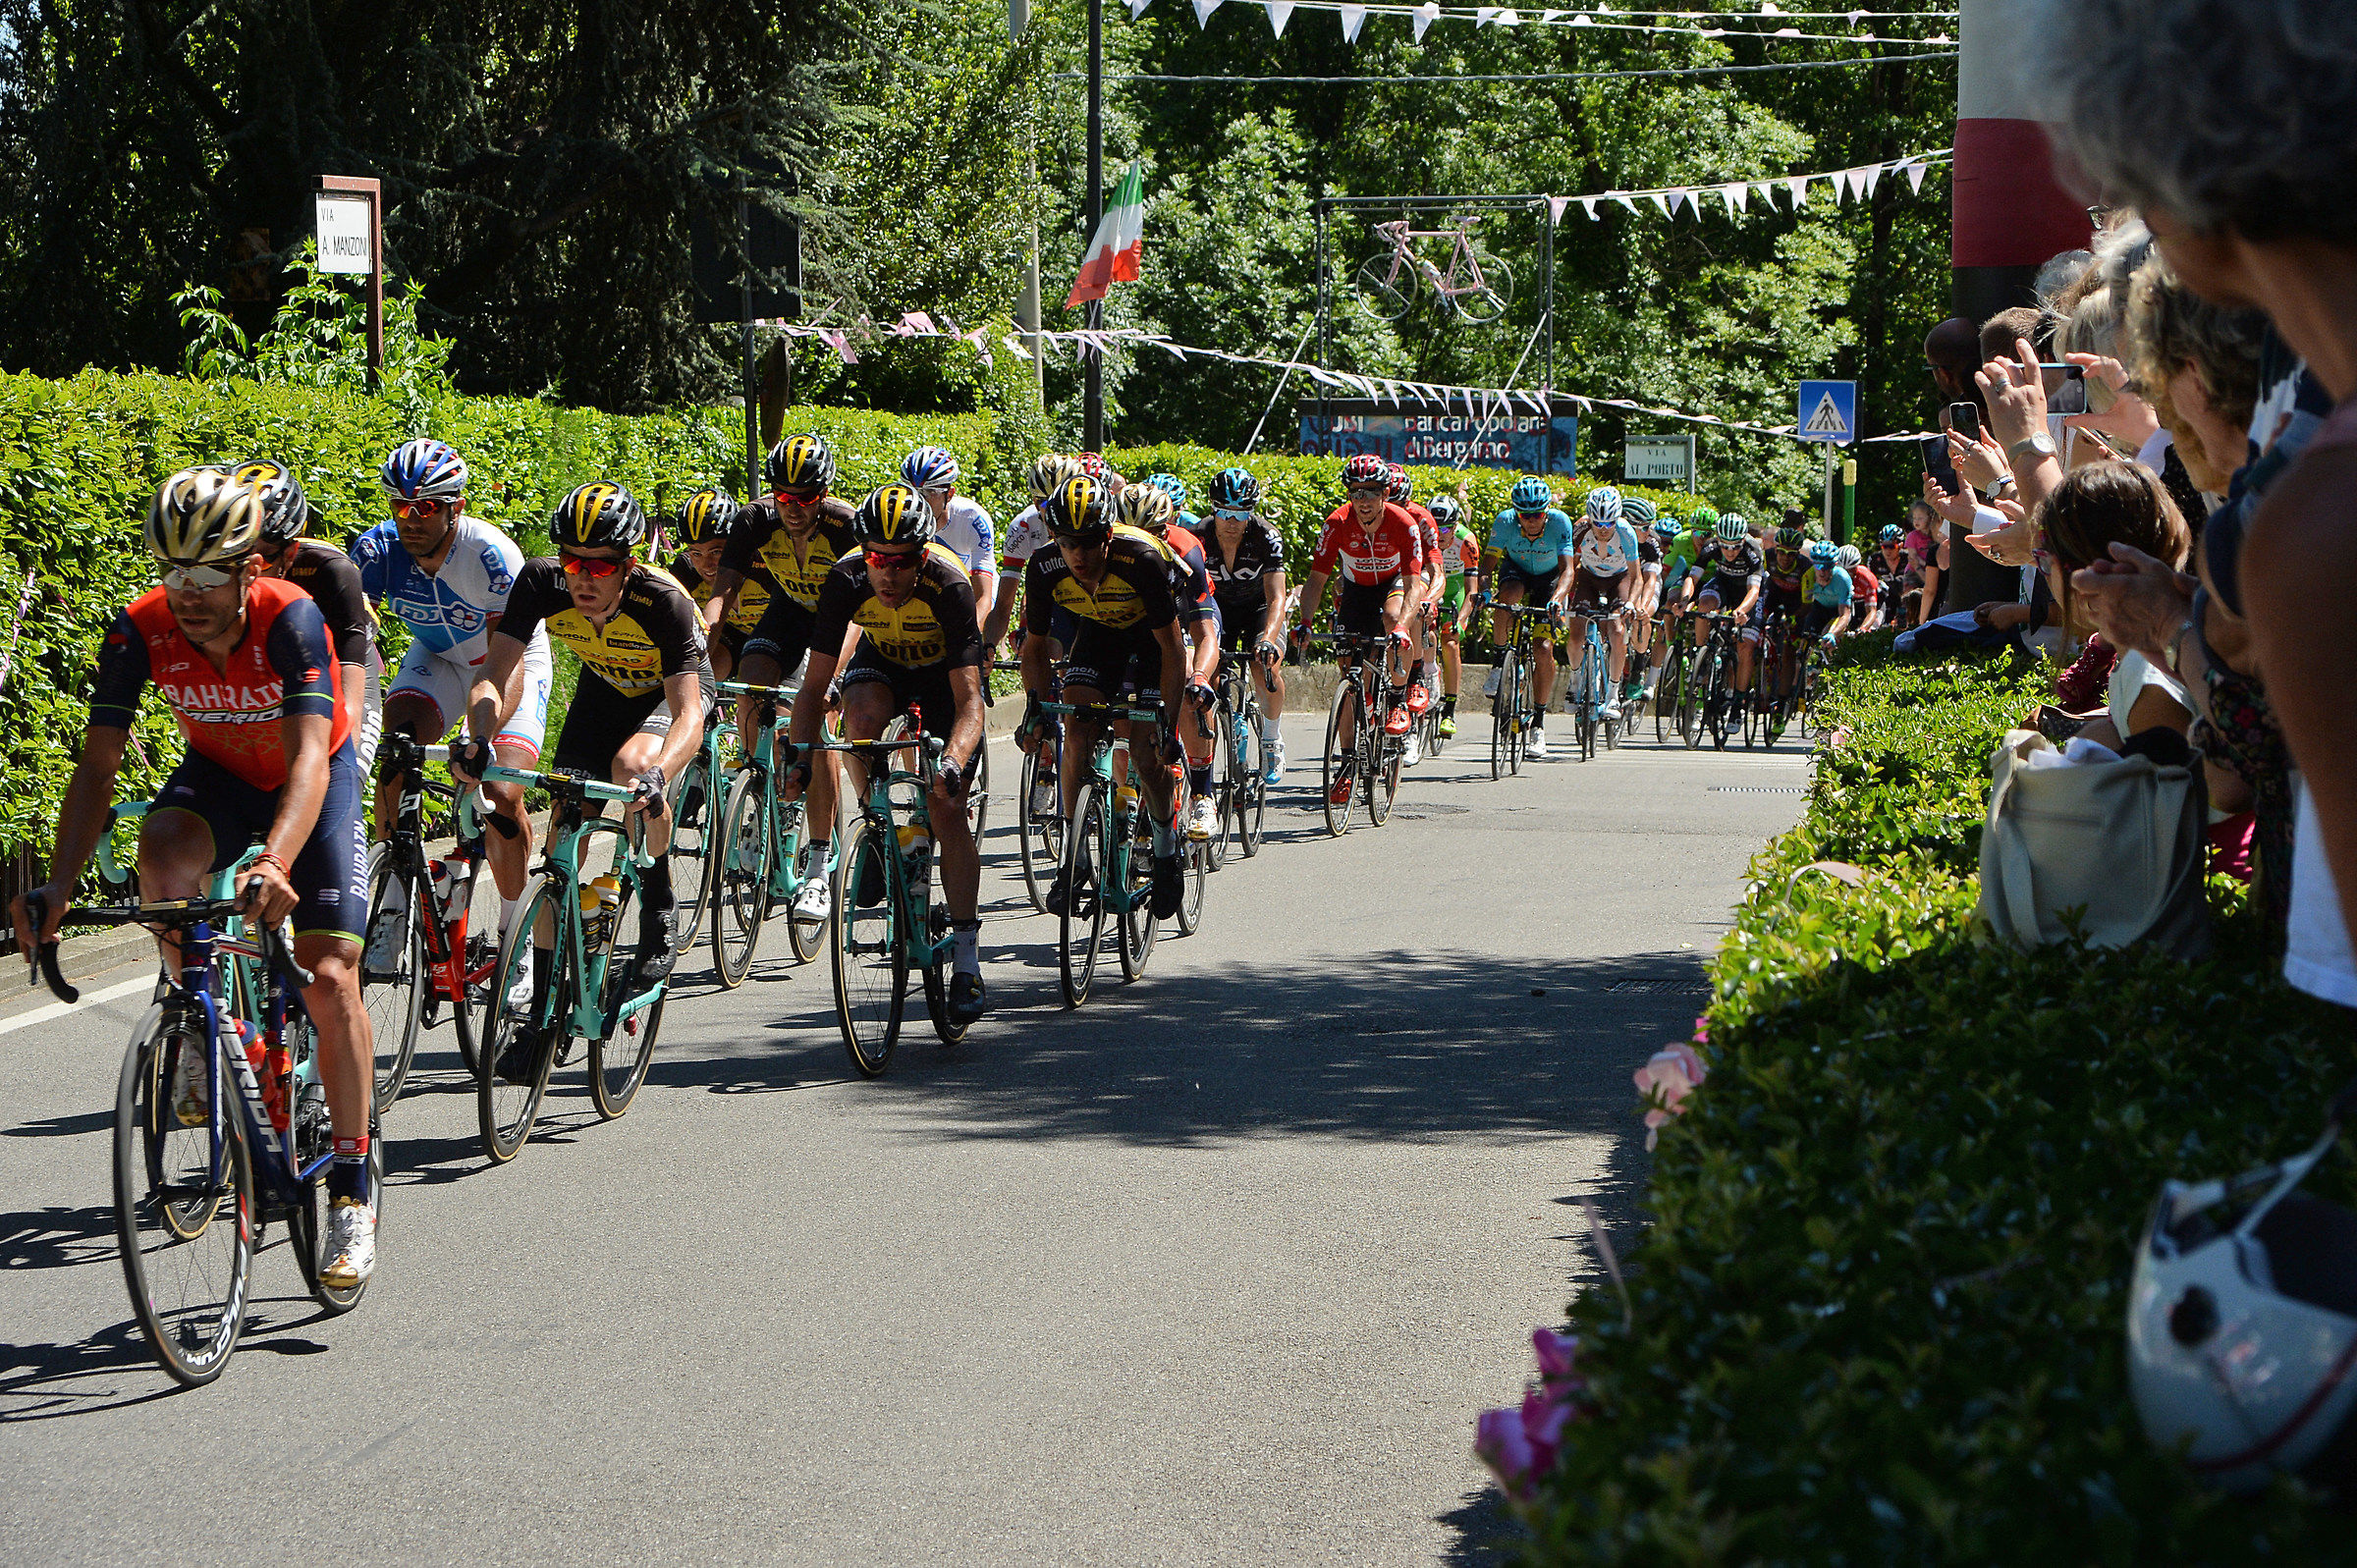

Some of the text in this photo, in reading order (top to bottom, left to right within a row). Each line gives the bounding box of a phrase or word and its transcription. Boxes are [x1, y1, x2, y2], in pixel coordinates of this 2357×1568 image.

[321, 208, 334, 221] VIA
[1404, 415, 1461, 432] Banca
[1423, 435, 1510, 464] Bergamo
[1647, 463, 1683, 475] PORTO
[1007, 533, 1025, 554] Bapco
[400, 605, 440, 622] FDJ
[586, 659, 657, 679] otto
[163, 678, 285, 710] BAHRAIN
[350, 819, 369, 902] BAHRAIN
[212, 998, 283, 1153] MERIDA
